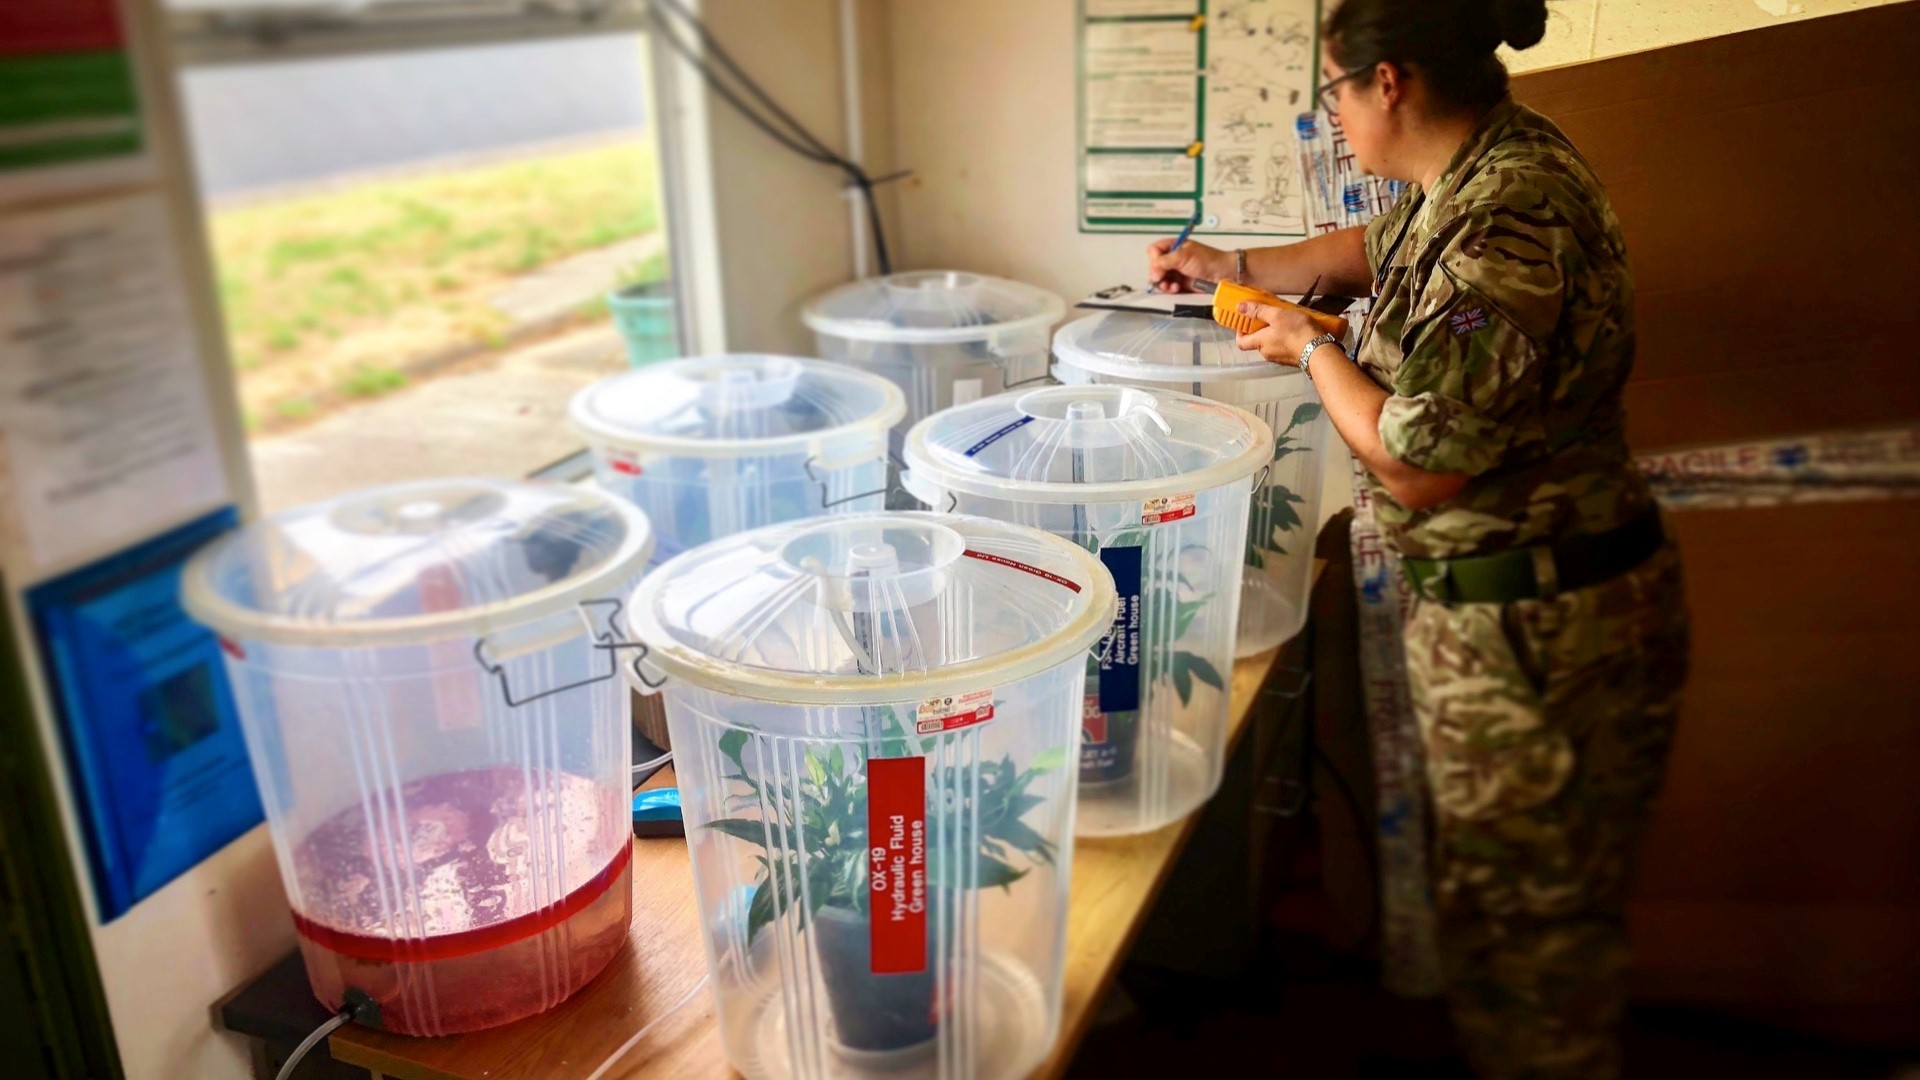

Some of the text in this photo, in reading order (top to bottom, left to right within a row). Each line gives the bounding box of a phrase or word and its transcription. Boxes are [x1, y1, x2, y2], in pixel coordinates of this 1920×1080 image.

[1635, 446, 1760, 476] RAGILE
[1018, 564, 1042, 575] Green
[1115, 597, 1126, 664] Aircraft Fuel
[1127, 594, 1140, 665] Green house
[871, 846, 887, 892] OX-19
[890, 815, 905, 921] Hydraulic Fluid
[909, 820, 924, 913] Green house
